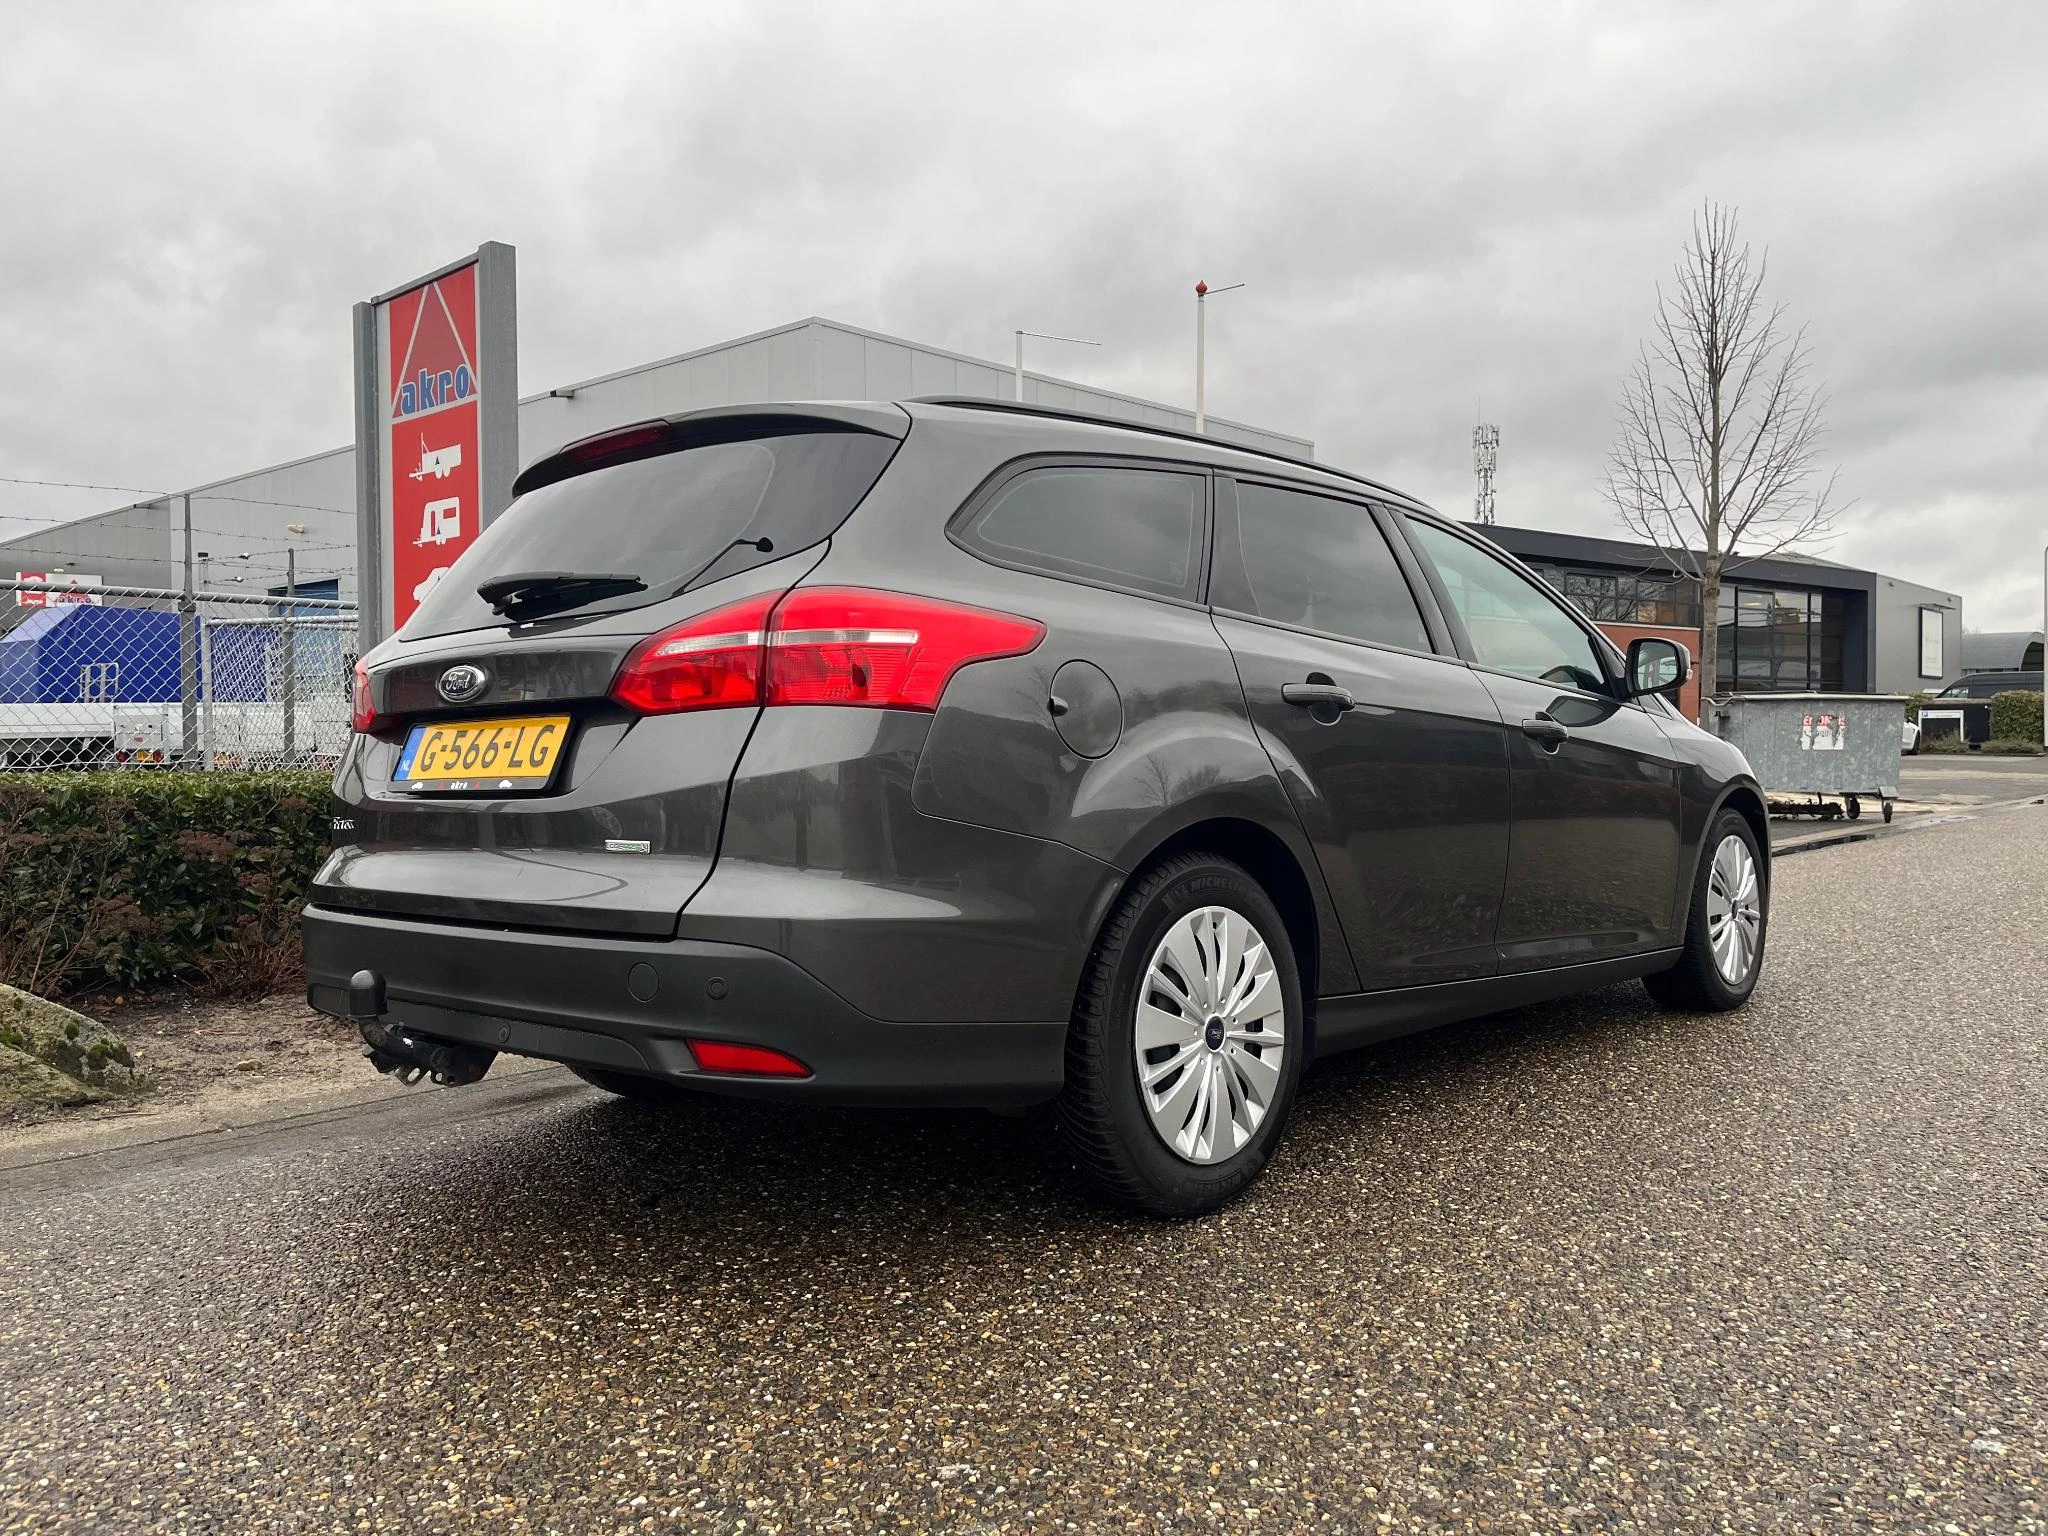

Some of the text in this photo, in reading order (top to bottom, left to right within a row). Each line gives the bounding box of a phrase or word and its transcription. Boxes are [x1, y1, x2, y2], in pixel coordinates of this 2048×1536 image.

[401, 364, 471, 415] akro
[421, 725, 554, 772] G-566-LG
[400, 759, 411, 771] NL
[450, 780, 468, 790] akro
